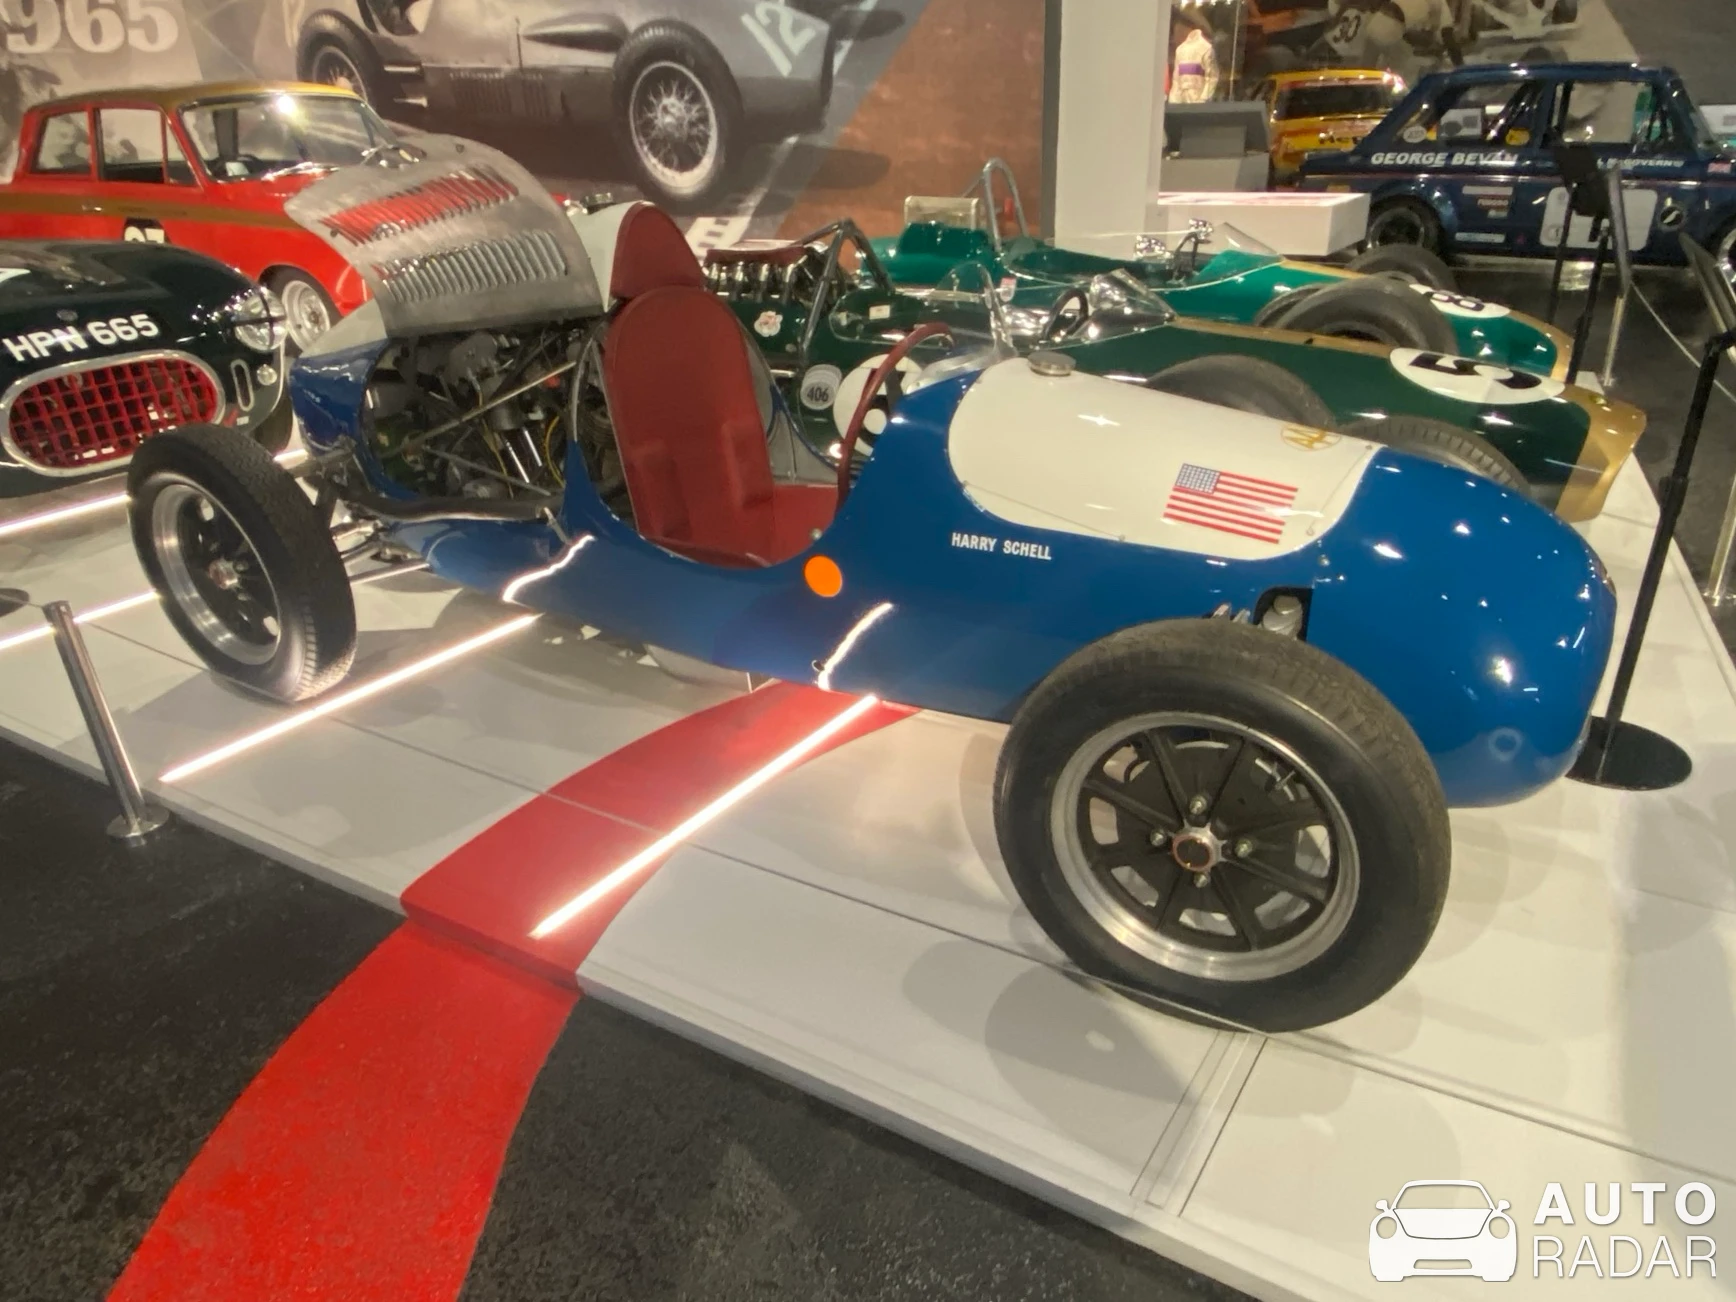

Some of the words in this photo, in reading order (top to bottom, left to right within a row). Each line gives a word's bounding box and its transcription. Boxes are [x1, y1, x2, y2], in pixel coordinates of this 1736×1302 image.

[741, 0, 816, 77] 12
[1371, 152, 1449, 167] GEORGE
[1451, 151, 1518, 167] BEVAN
[2, 325, 88, 362] HPN
[87, 313, 159, 345] 665
[806, 386, 829, 404] 406
[951, 531, 998, 553] HARRY
[1002, 539, 1052, 561] SCHELL
